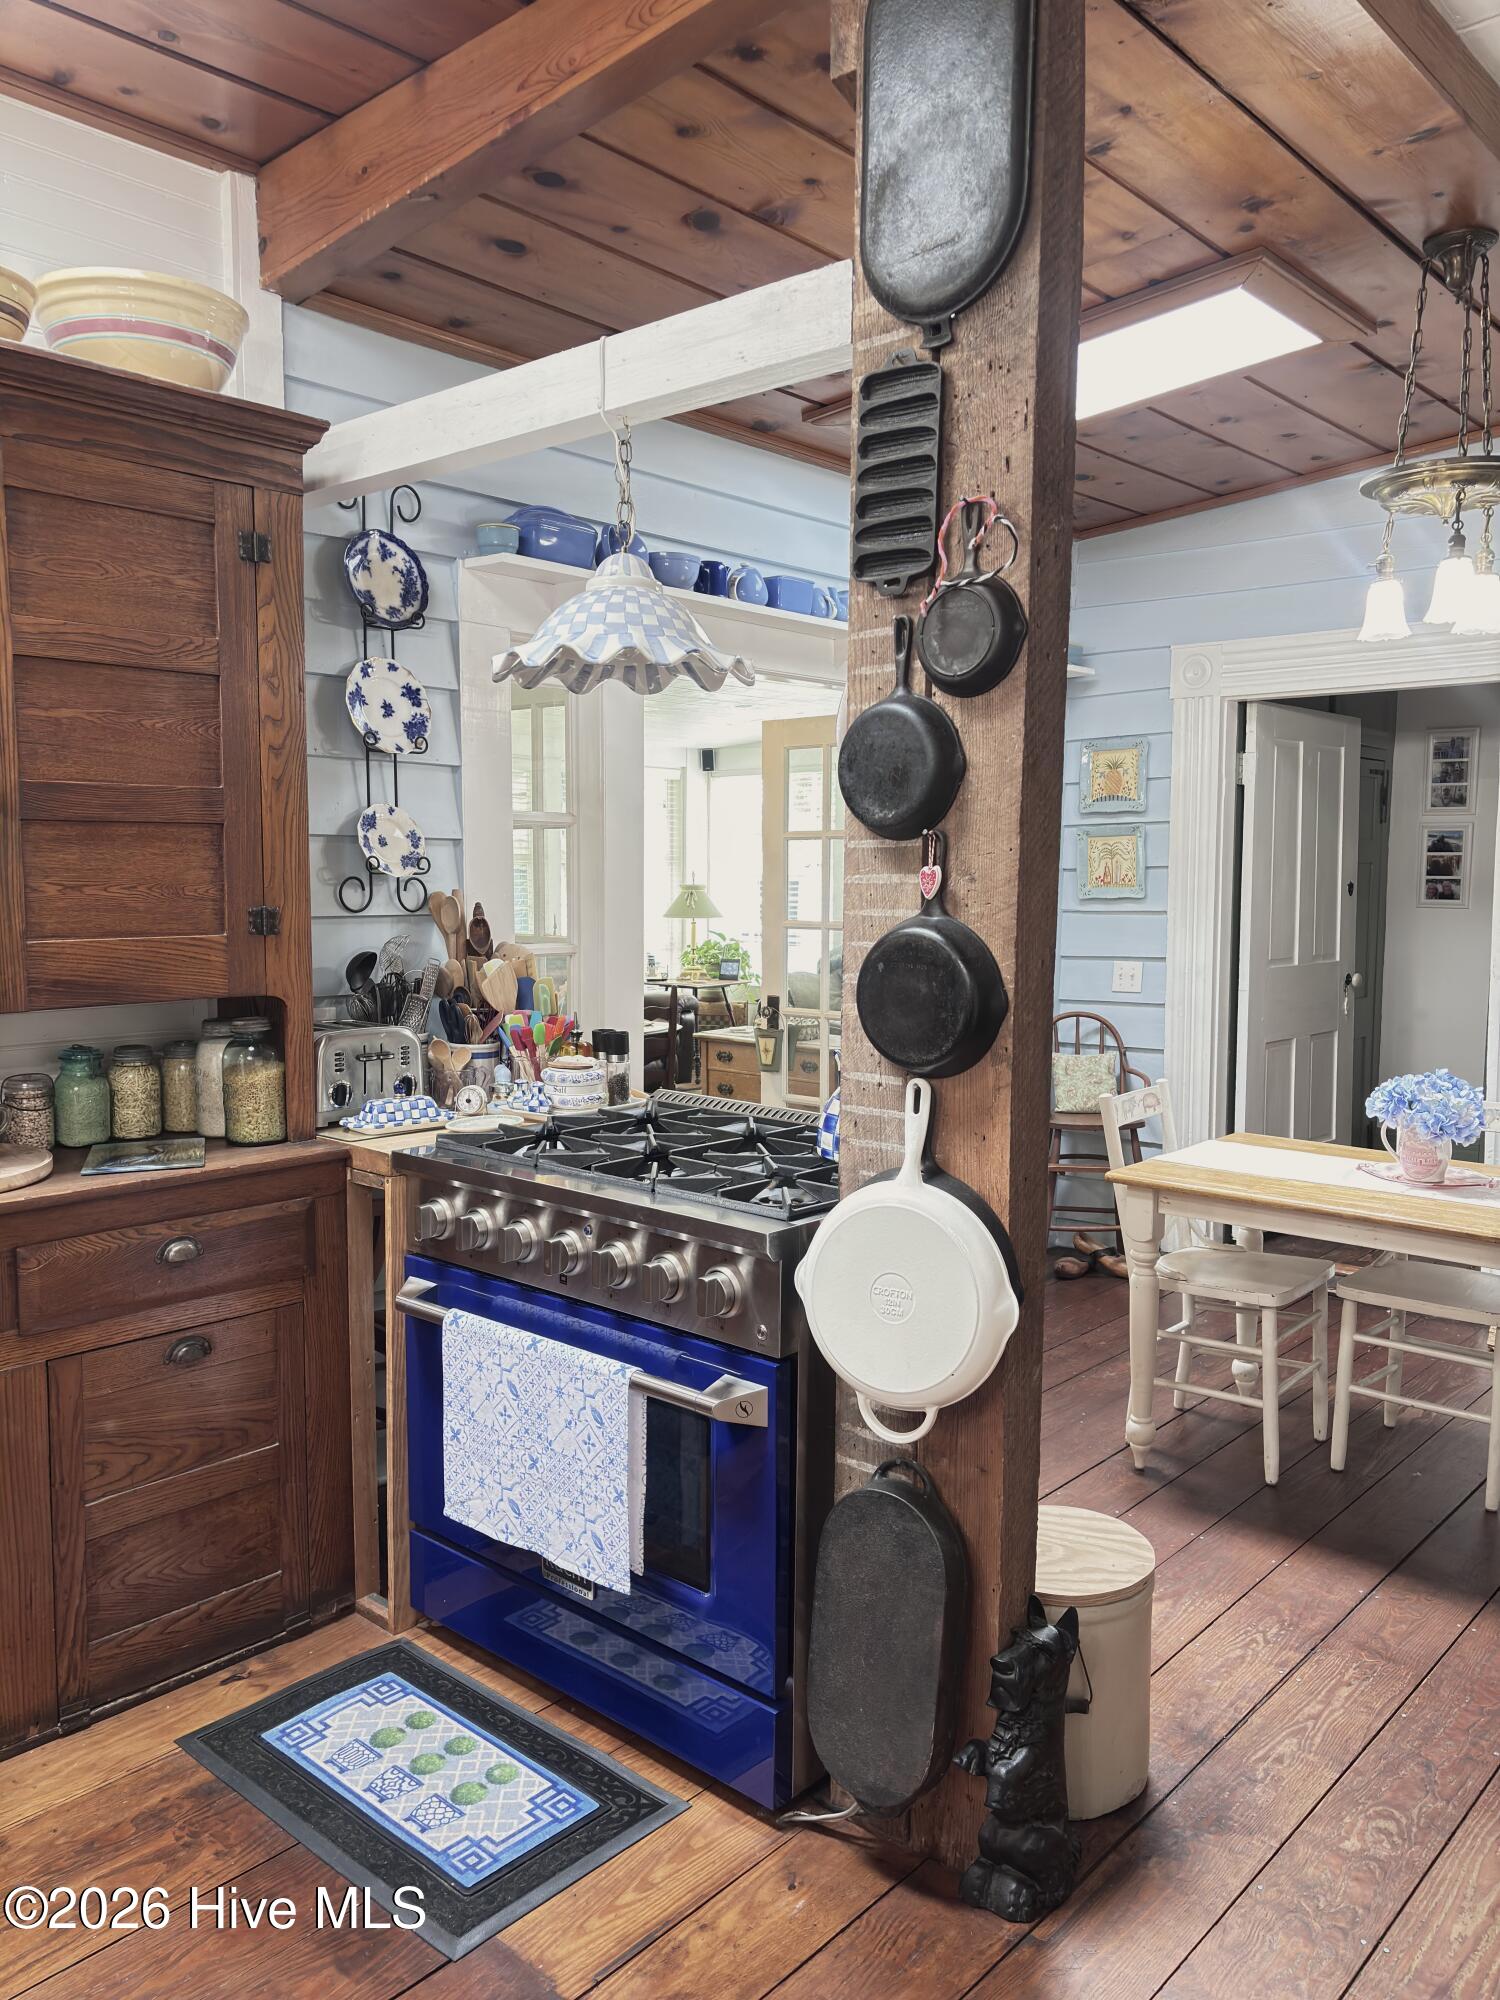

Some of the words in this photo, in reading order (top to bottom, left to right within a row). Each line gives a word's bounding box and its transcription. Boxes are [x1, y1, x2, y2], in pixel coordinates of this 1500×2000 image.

[553, 1086, 567, 1094] Salt
[873, 1287, 913, 1301] CROFTON
[546, 1572, 590, 1598] Professional
